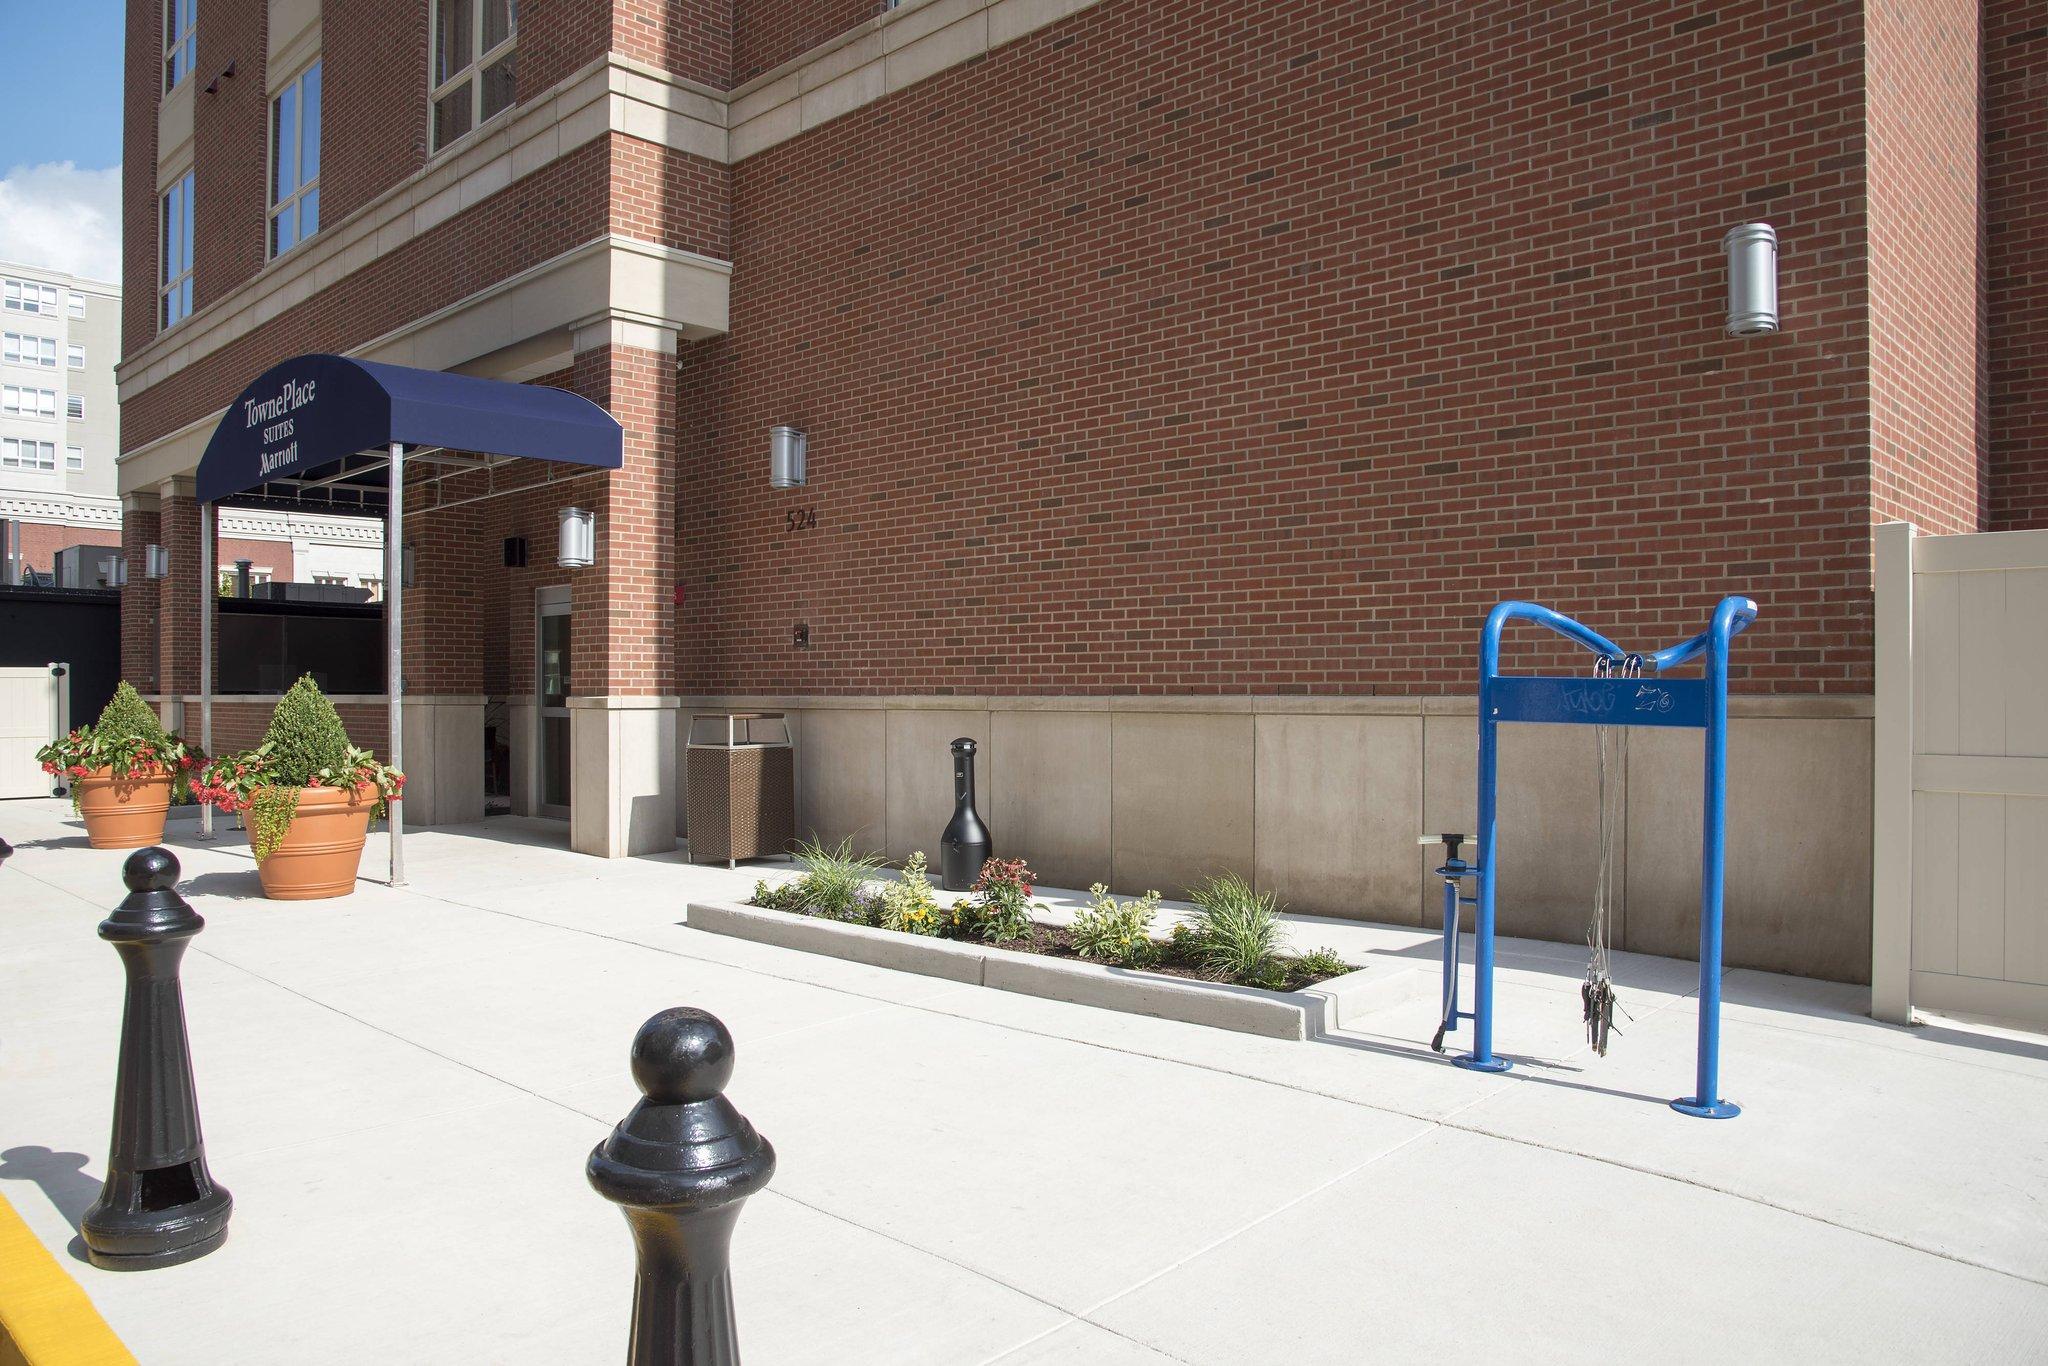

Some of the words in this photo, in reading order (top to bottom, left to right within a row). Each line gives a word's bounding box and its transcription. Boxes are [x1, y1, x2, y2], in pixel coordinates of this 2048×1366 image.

[244, 378, 316, 428] TownePlace
[263, 418, 294, 445] SUITES
[259, 441, 298, 477] Marriott
[786, 507, 817, 532] 524
